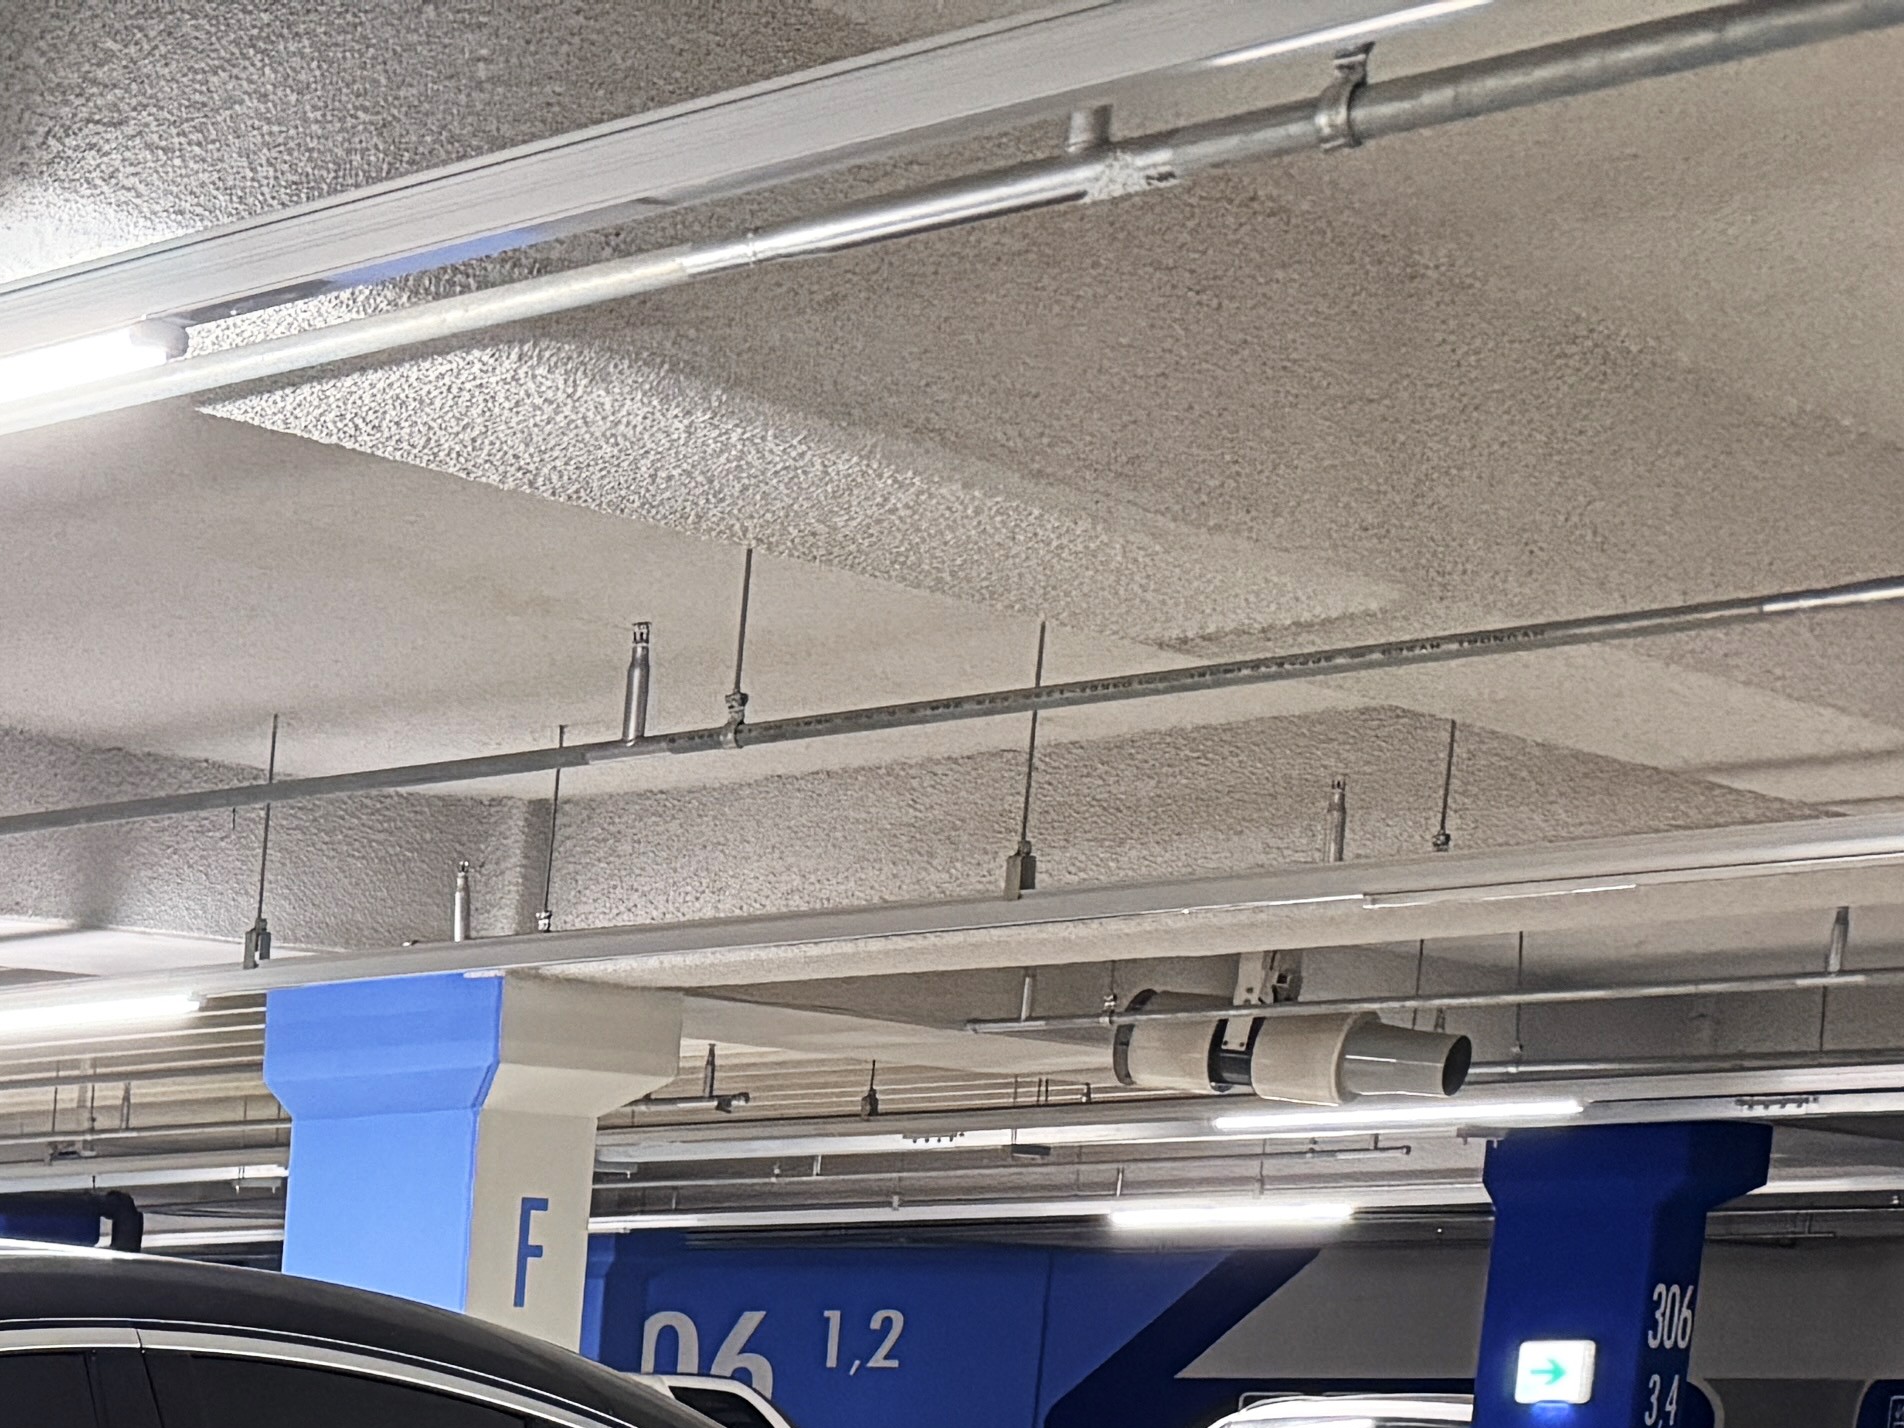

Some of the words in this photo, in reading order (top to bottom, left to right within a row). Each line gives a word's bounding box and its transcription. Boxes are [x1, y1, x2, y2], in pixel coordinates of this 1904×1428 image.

[513, 1197, 549, 1308] F
[823, 1309, 904, 1376] 1,2
[1647, 1283, 1694, 1349] 306
